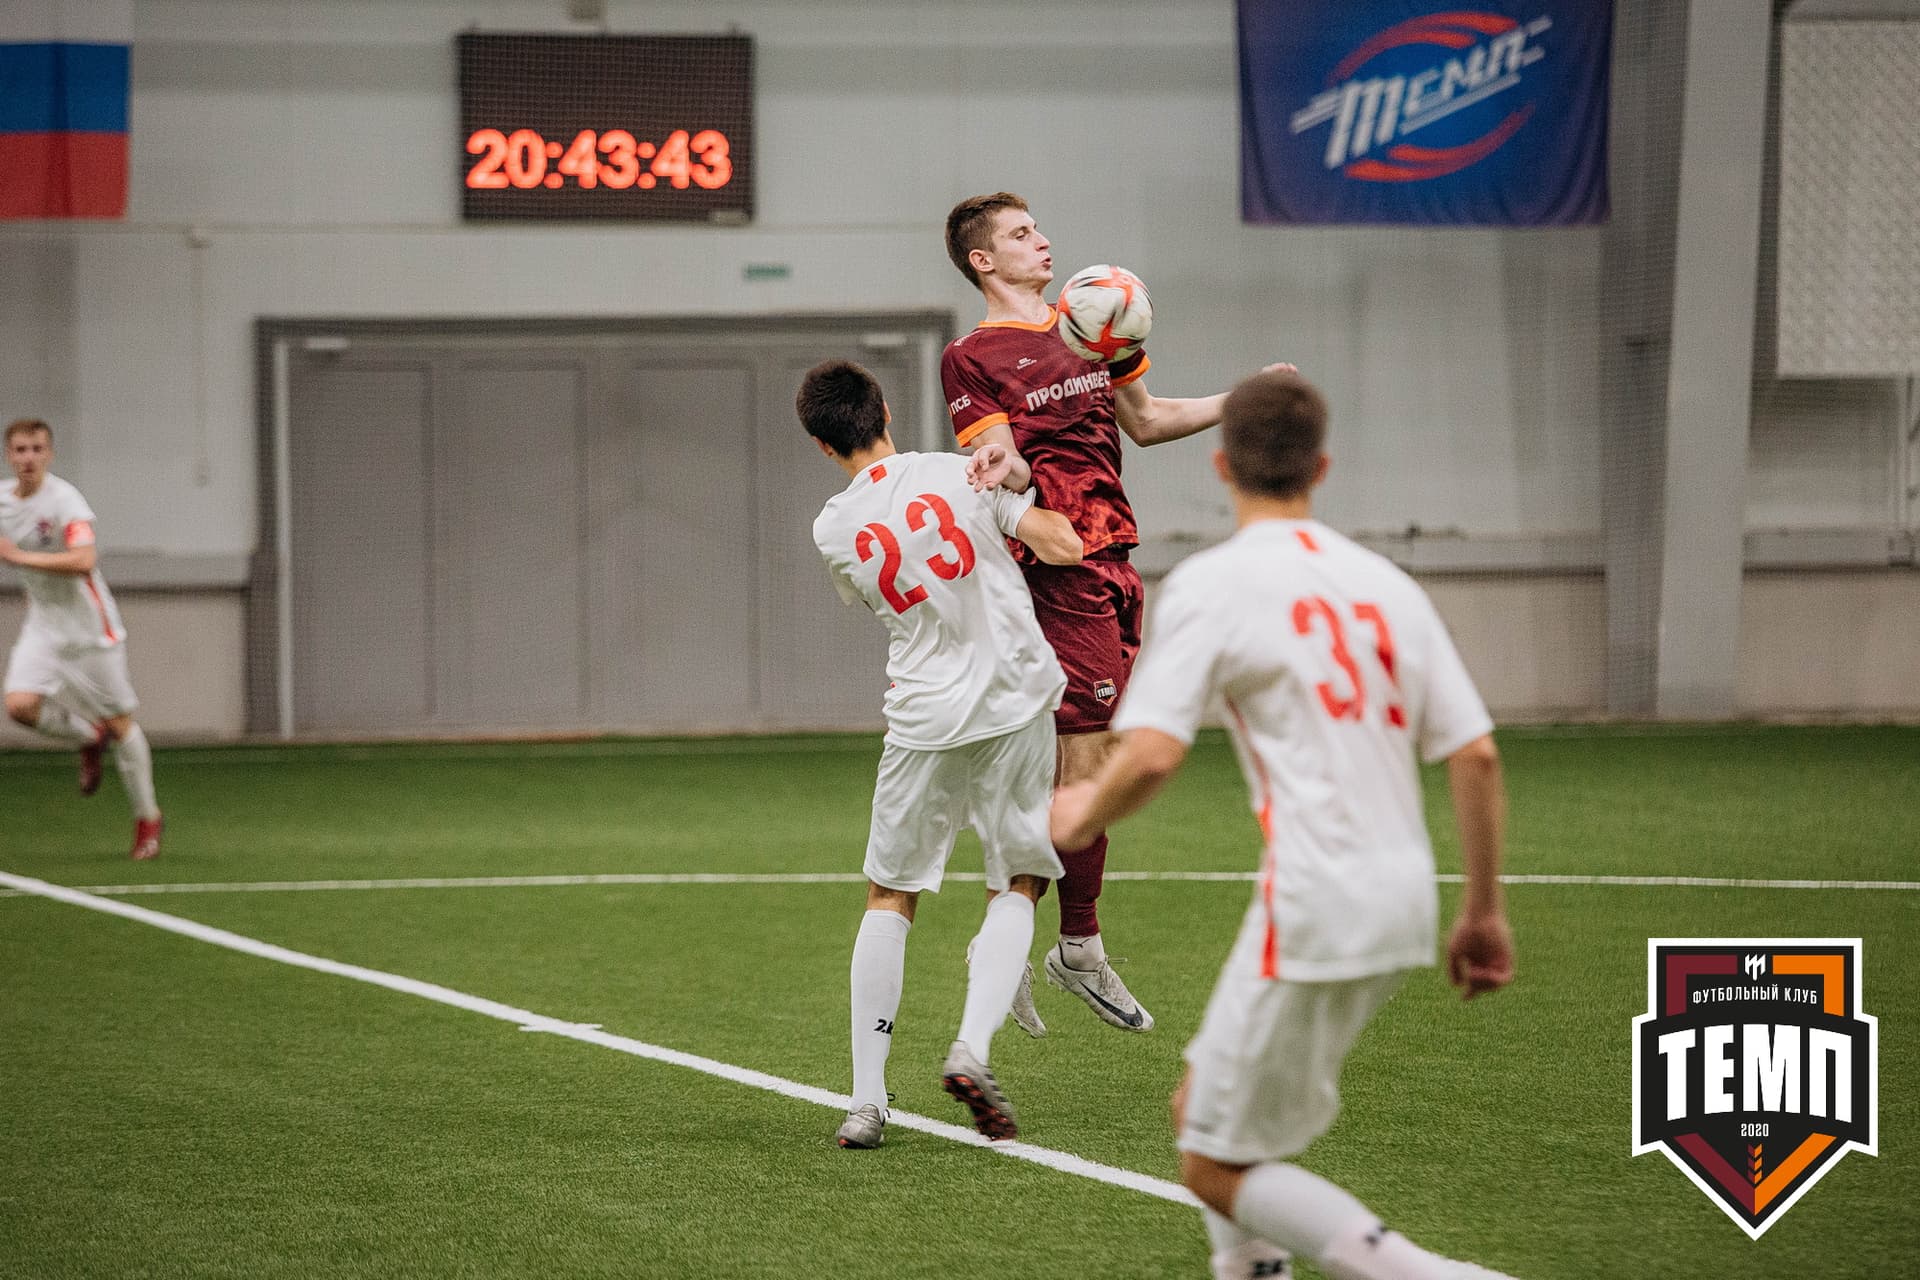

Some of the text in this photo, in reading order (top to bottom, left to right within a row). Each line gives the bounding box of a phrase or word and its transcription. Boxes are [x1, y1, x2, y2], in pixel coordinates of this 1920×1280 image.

[466, 128, 733, 189] 20:43:43
[950, 394, 972, 415] ПСБ
[855, 493, 976, 615] 23
